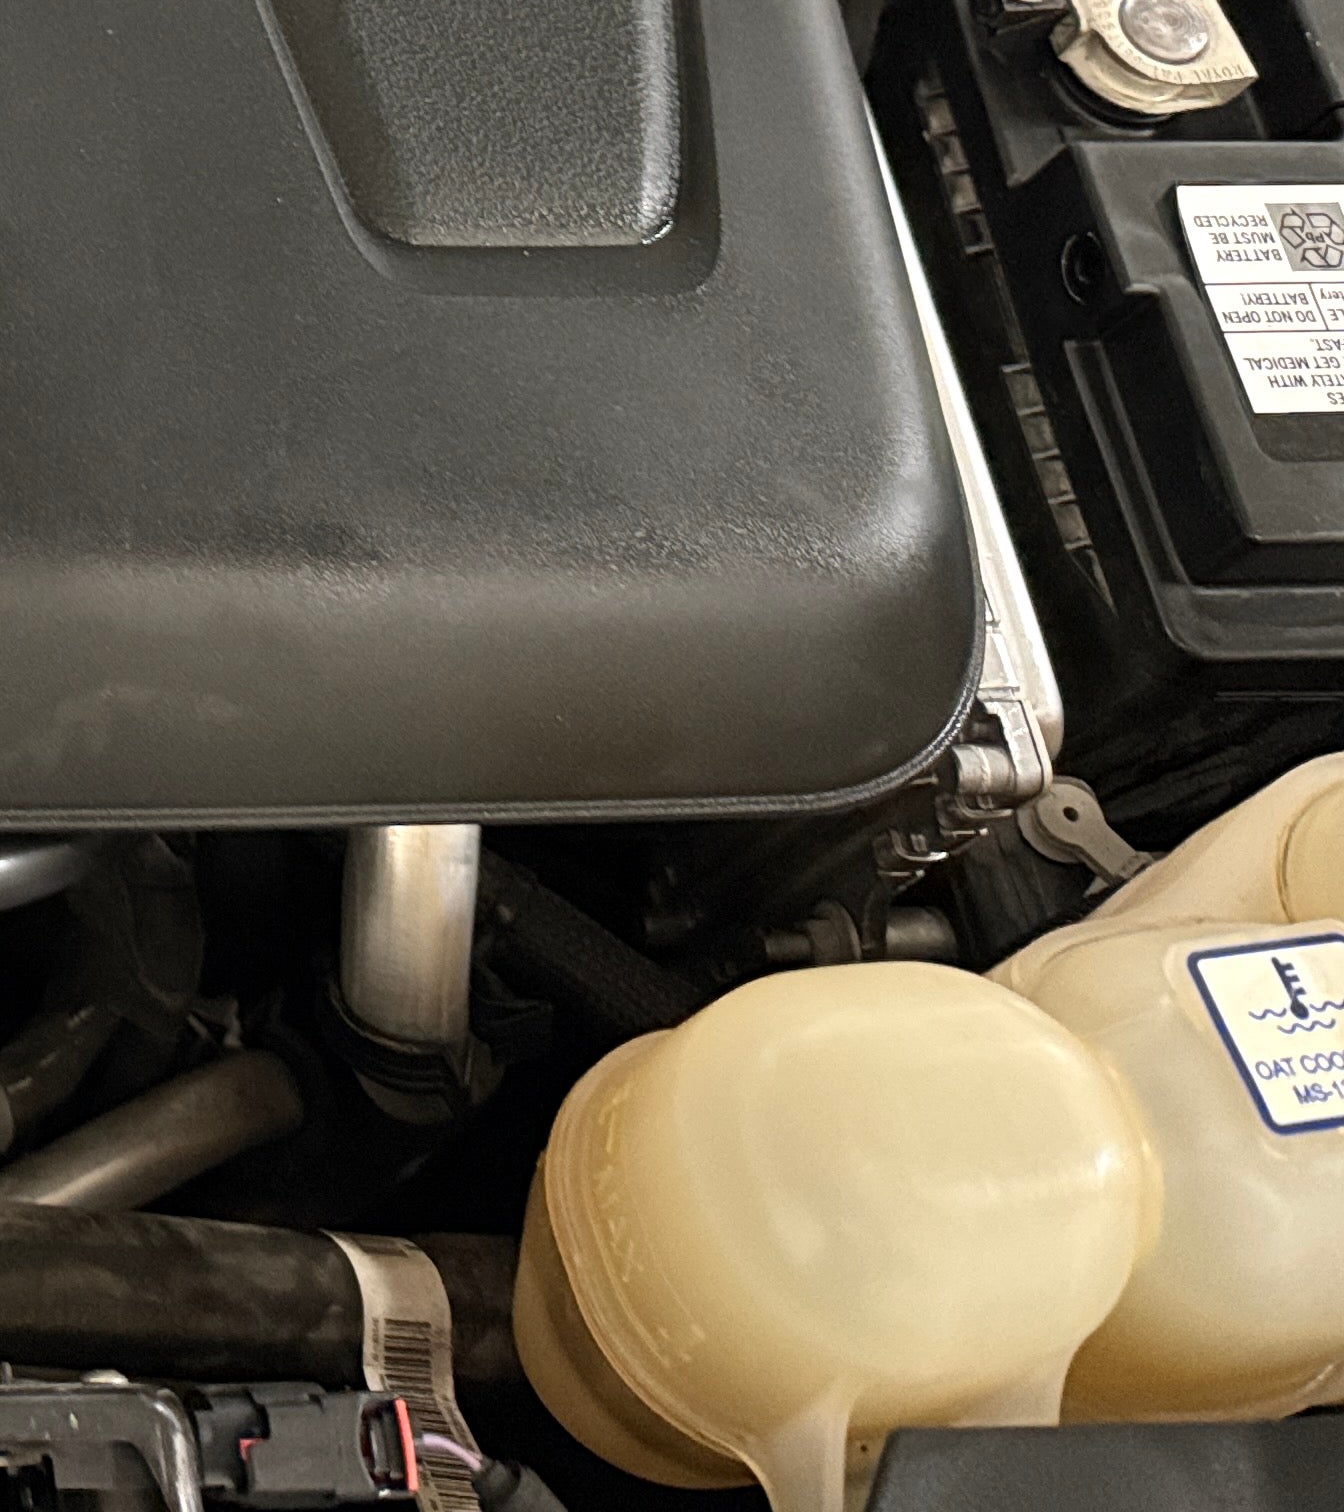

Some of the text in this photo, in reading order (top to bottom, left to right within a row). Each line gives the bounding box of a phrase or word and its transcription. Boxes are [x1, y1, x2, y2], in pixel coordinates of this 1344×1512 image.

[1193, 214, 1268, 228] RECYCLED
[1209, 231, 1275, 245] MUST BE
[1305, 231, 1325, 244] Pb
[1215, 247, 1283, 262] BATTERY
[1240, 292, 1309, 306] BATTERY!
[1222, 310, 1317, 324] DO NOT OPEN
[1243, 356, 1340, 371] GET MEDICAL
[1267, 374, 1307, 388] WITH
[1255, 1057, 1296, 1080] OAT
[1292, 1080, 1344, 1105] MS-1
